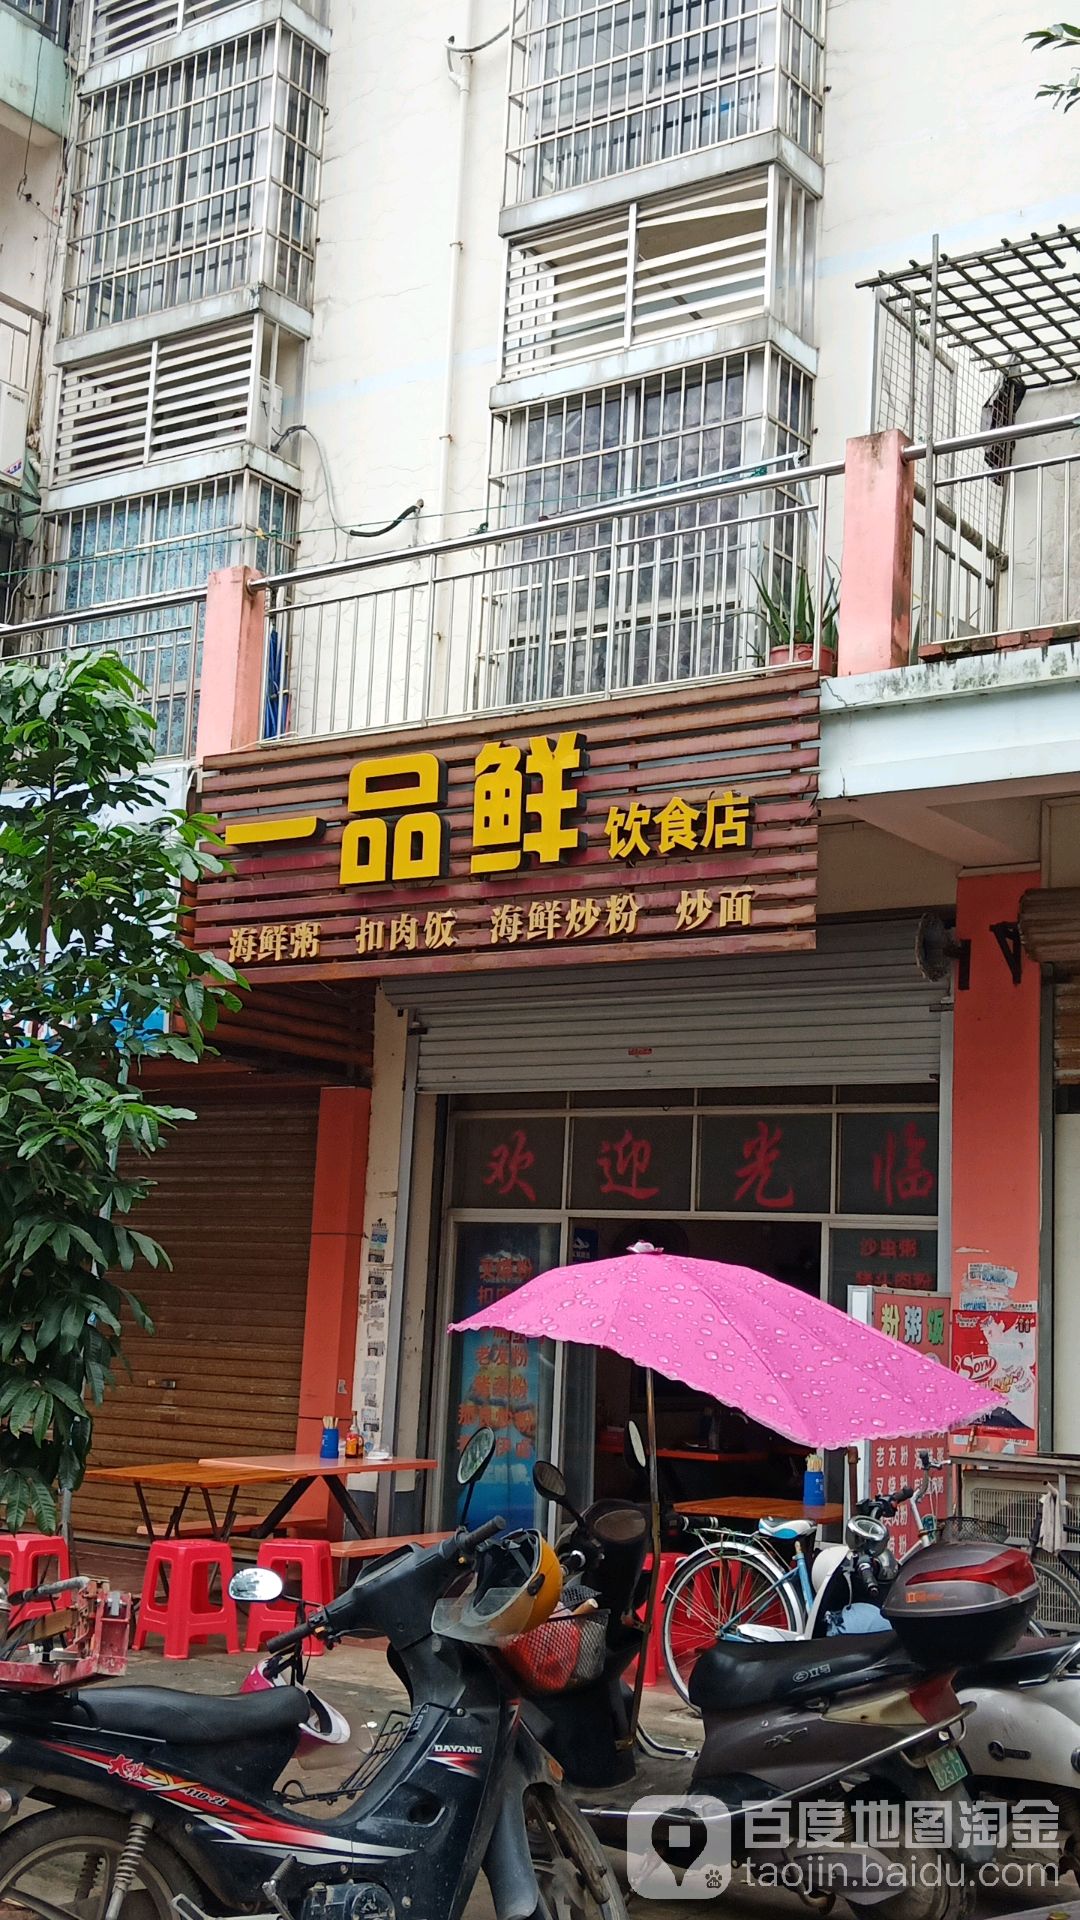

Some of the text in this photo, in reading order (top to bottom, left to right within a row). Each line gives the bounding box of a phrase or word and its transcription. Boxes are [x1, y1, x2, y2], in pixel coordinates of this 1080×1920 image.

[225, 731, 751, 886] 一品鲜 饮食店
[227, 886, 755, 964] 海鲜粥 扣肉饭 海鲜炒粉 炒面
[483, 1120, 936, 1209] 欢迎光临
[876, 1445, 909, 1467] 老友粉
[434, 1744, 482, 1753] DAYANG
